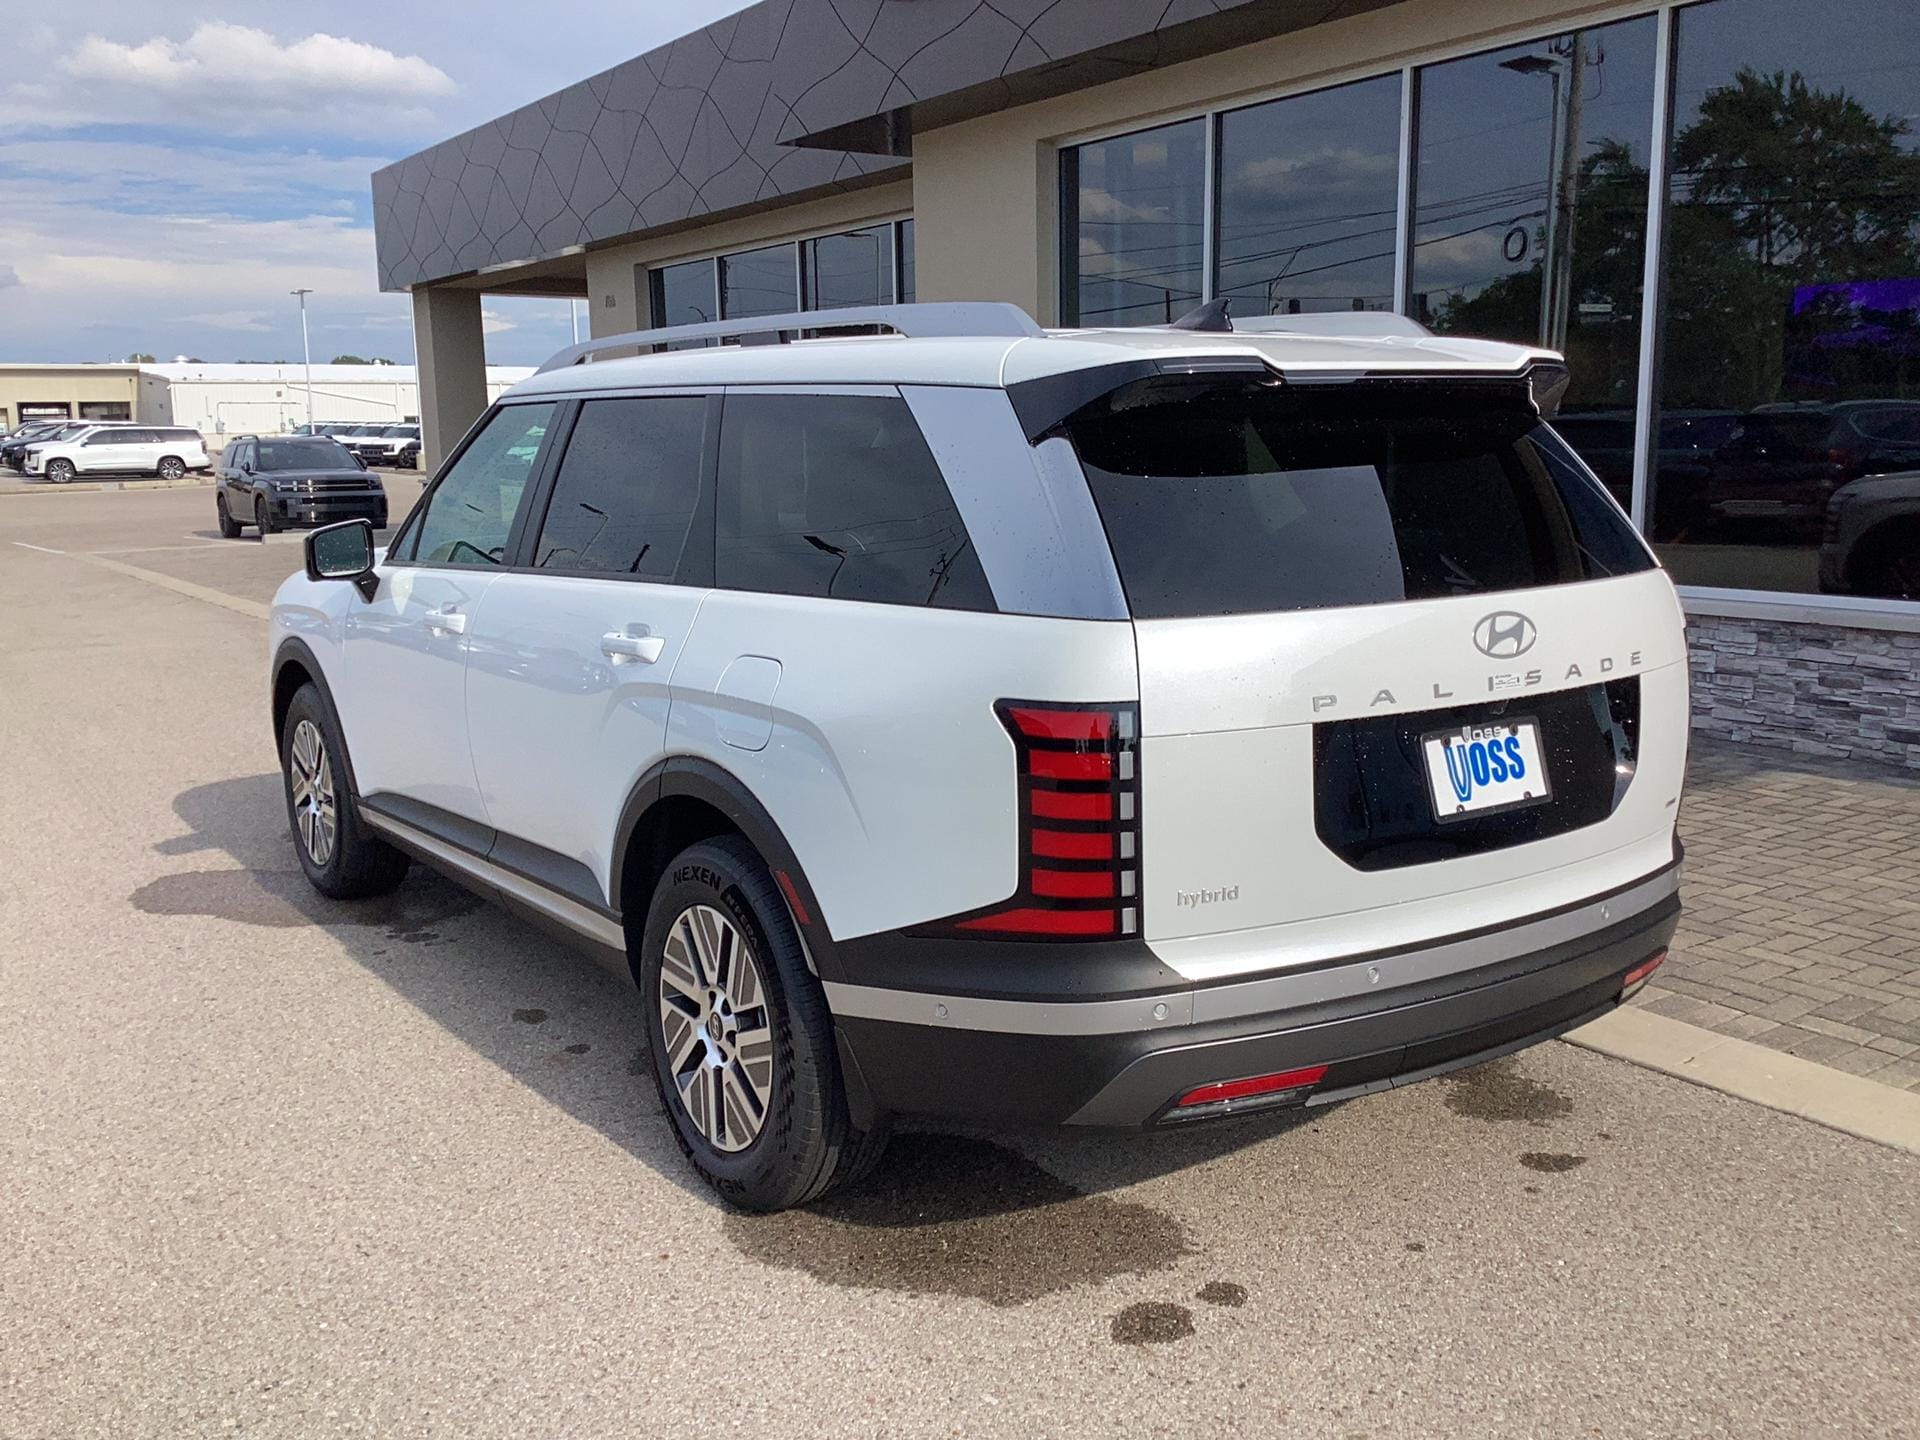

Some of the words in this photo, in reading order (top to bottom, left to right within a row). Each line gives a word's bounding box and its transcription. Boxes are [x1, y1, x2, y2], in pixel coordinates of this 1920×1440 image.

[1312, 651, 1642, 712] PALISADE
[1443, 736, 1525, 802] VOSS
[673, 865, 722, 891] NEXEN
[1176, 885, 1239, 909] hybrid
